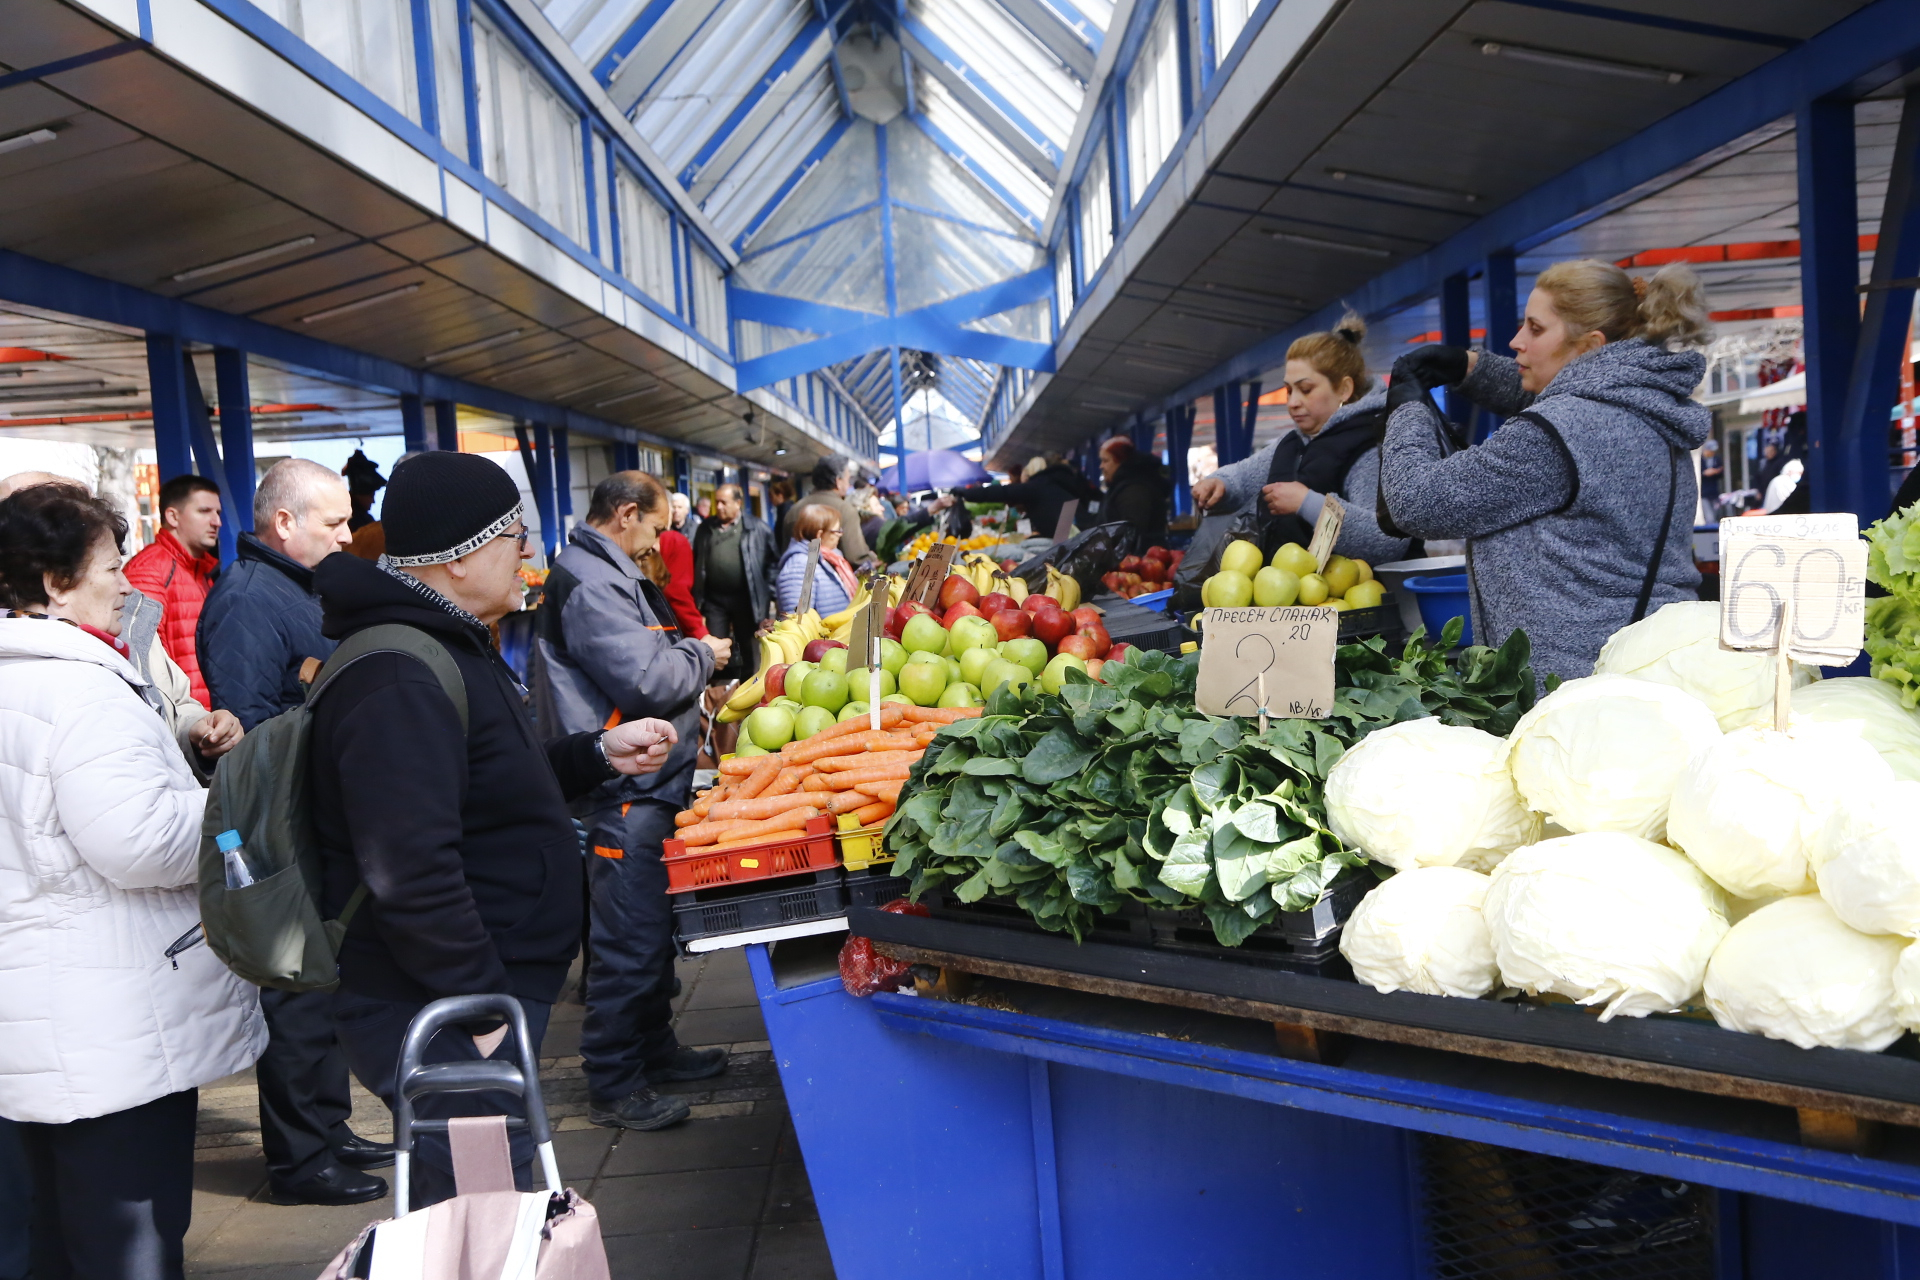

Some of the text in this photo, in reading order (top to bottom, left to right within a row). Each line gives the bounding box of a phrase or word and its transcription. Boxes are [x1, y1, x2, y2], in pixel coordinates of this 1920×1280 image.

[1210, 607, 1332, 624] ПРЕСЕН СПАНАК
[1728, 544, 1845, 641] 60
